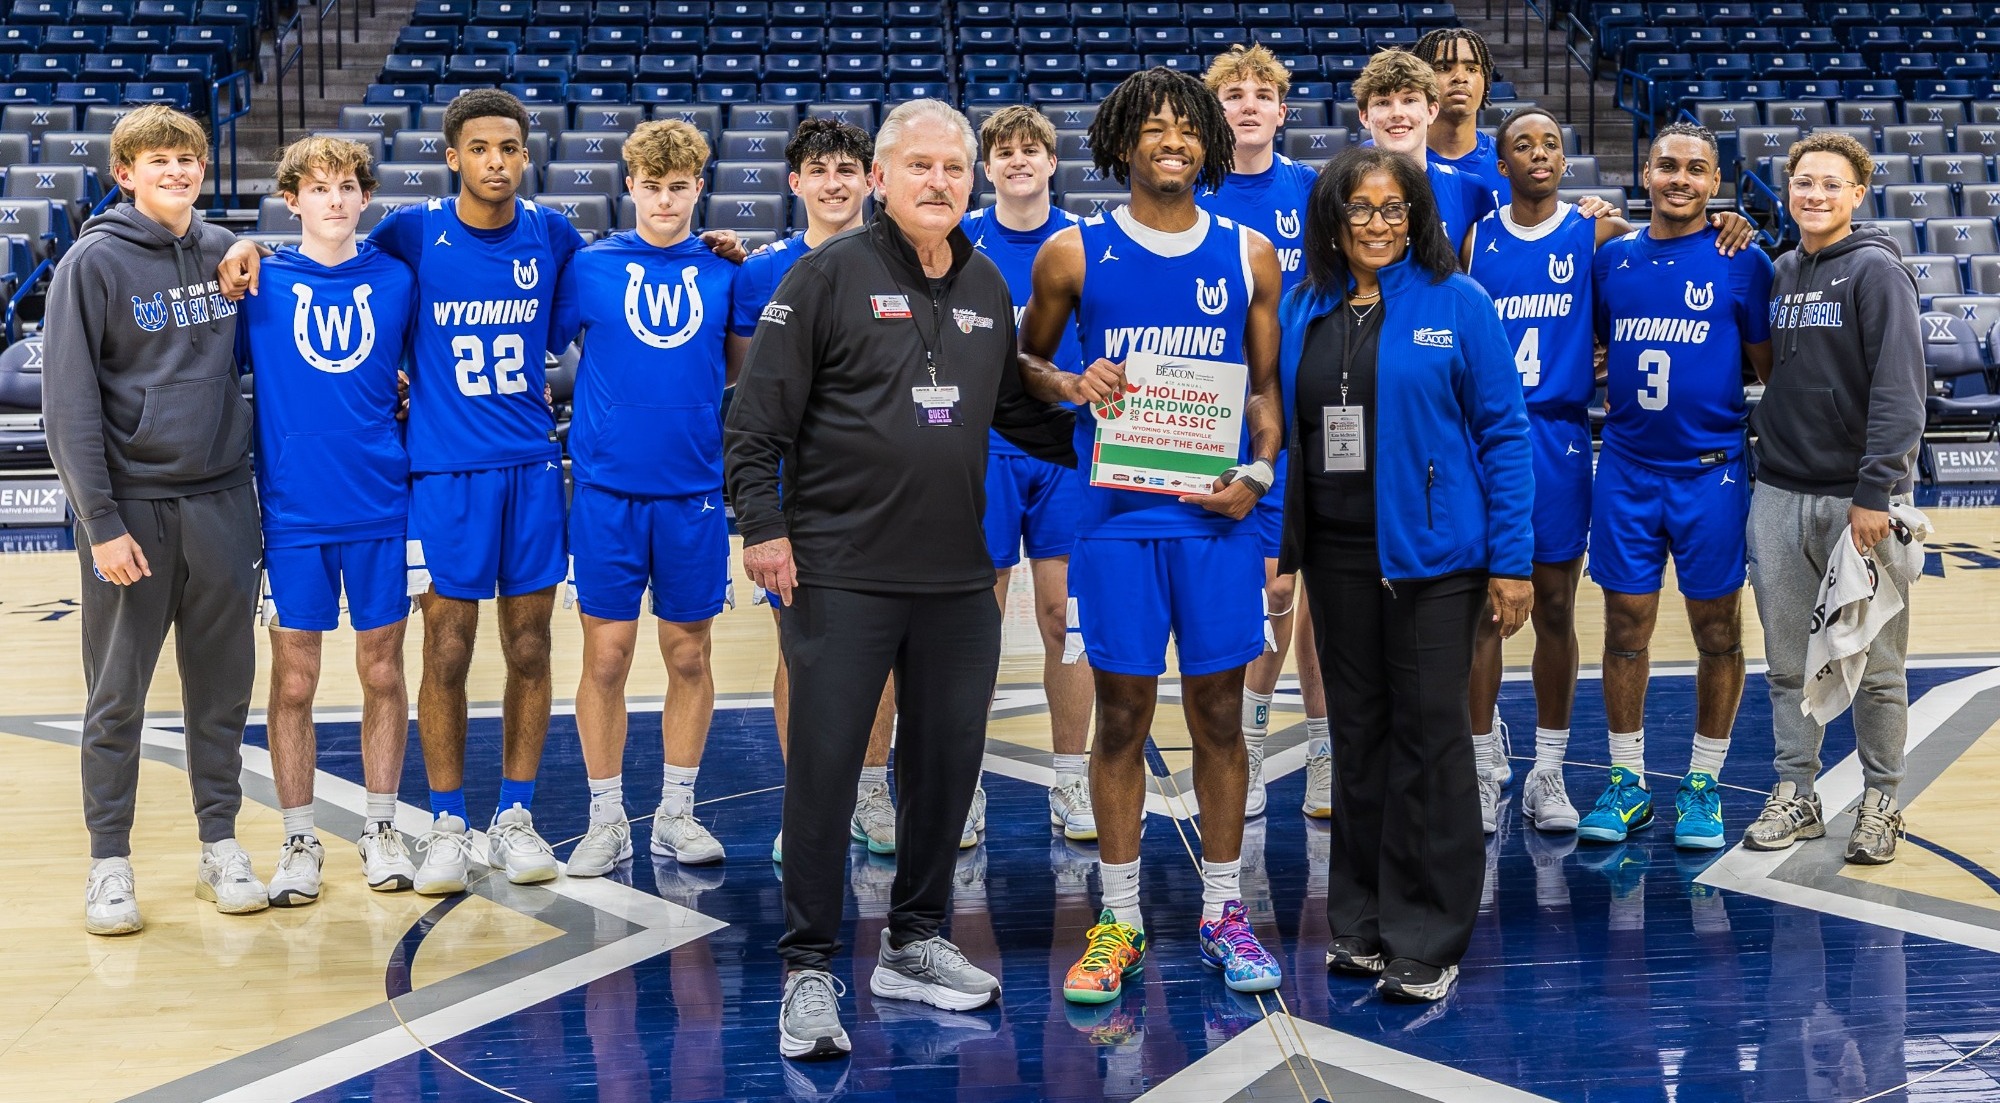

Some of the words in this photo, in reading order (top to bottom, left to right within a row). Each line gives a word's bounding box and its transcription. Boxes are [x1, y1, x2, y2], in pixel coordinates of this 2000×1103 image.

[31, 110, 50, 125] X
[368, 112, 386, 127] X
[602, 111, 619, 126] X
[680, 111, 697, 125] X
[755, 110, 773, 125] X
[831, 110, 848, 124] X
[1064, 110, 1081, 123] X
[1286, 107, 1302, 121] X
[1719, 107, 1736, 122] X
[1789, 107, 1806, 121] X
[1858, 107, 1876, 121] X
[1927, 107, 1944, 122] X
[419, 137, 438, 153] X
[586, 138, 603, 153] X
[748, 137, 766, 152] X
[1310, 134, 1327, 149] X
[1762, 132, 1781, 147] X
[1906, 131, 1924, 146] X
[1979, 130, 1997, 145] X
[70, 139, 89, 156] X
[1083, 166, 1103, 181] X
[1873, 160, 1890, 175] X
[1945, 160, 1964, 175] X
[36, 172, 56, 189] X
[404, 170, 423, 185] X
[574, 169, 593, 185] X
[743, 168, 762, 184] X
[1091, 199, 1109, 214] X
[1909, 191, 1928, 206] X
[0, 206, 20, 224] X
[560, 202, 580, 218] X
[737, 201, 756, 217] X
[1283, 216, 1295, 232] W
[1953, 225, 1972, 241] X
[519, 266, 532, 282] W
[1555, 260, 1567, 277] W
[1913, 263, 1932, 280] X
[168, 280, 220, 300] WOMNG
[1203, 286, 1220, 306] W
[1692, 288, 1706, 304] W
[141, 302, 159, 324] W
[433, 298, 540, 327] WYOMING
[644, 283, 682, 327] W
[1959, 304, 1979, 321] X
[1777, 302, 1843, 329] BSETBALL
[313, 305, 354, 351] W
[1614, 317, 1711, 344] WYOMING
[1924, 316, 1957, 341] X
[1104, 326, 1227, 359] WYOMING
[1413, 329, 1453, 345] BEACON
[451, 333, 528, 397] 22
[1515, 328, 1541, 387] 4
[1155, 364, 1195, 379] BEACON
[1637, 348, 1671, 411] 3
[1145, 385, 1220, 405] HOLIDAY
[927, 408, 950, 419] GUEST
[1130, 396, 1232, 419] HARDWOOD
[1143, 411, 1217, 431] CLASSIC
[1131, 425, 1162, 434] WYOMING
[1172, 429, 1212, 440] CENTERVILLE
[1115, 432, 1154, 445] PLAYER
[1156, 436, 1171, 446] OF
[1173, 438, 1193, 449] THE
[1195, 442, 1225, 453] GAME
[1937, 450, 1996, 467] FENIX
[0, 488, 58, 506] ENIX
